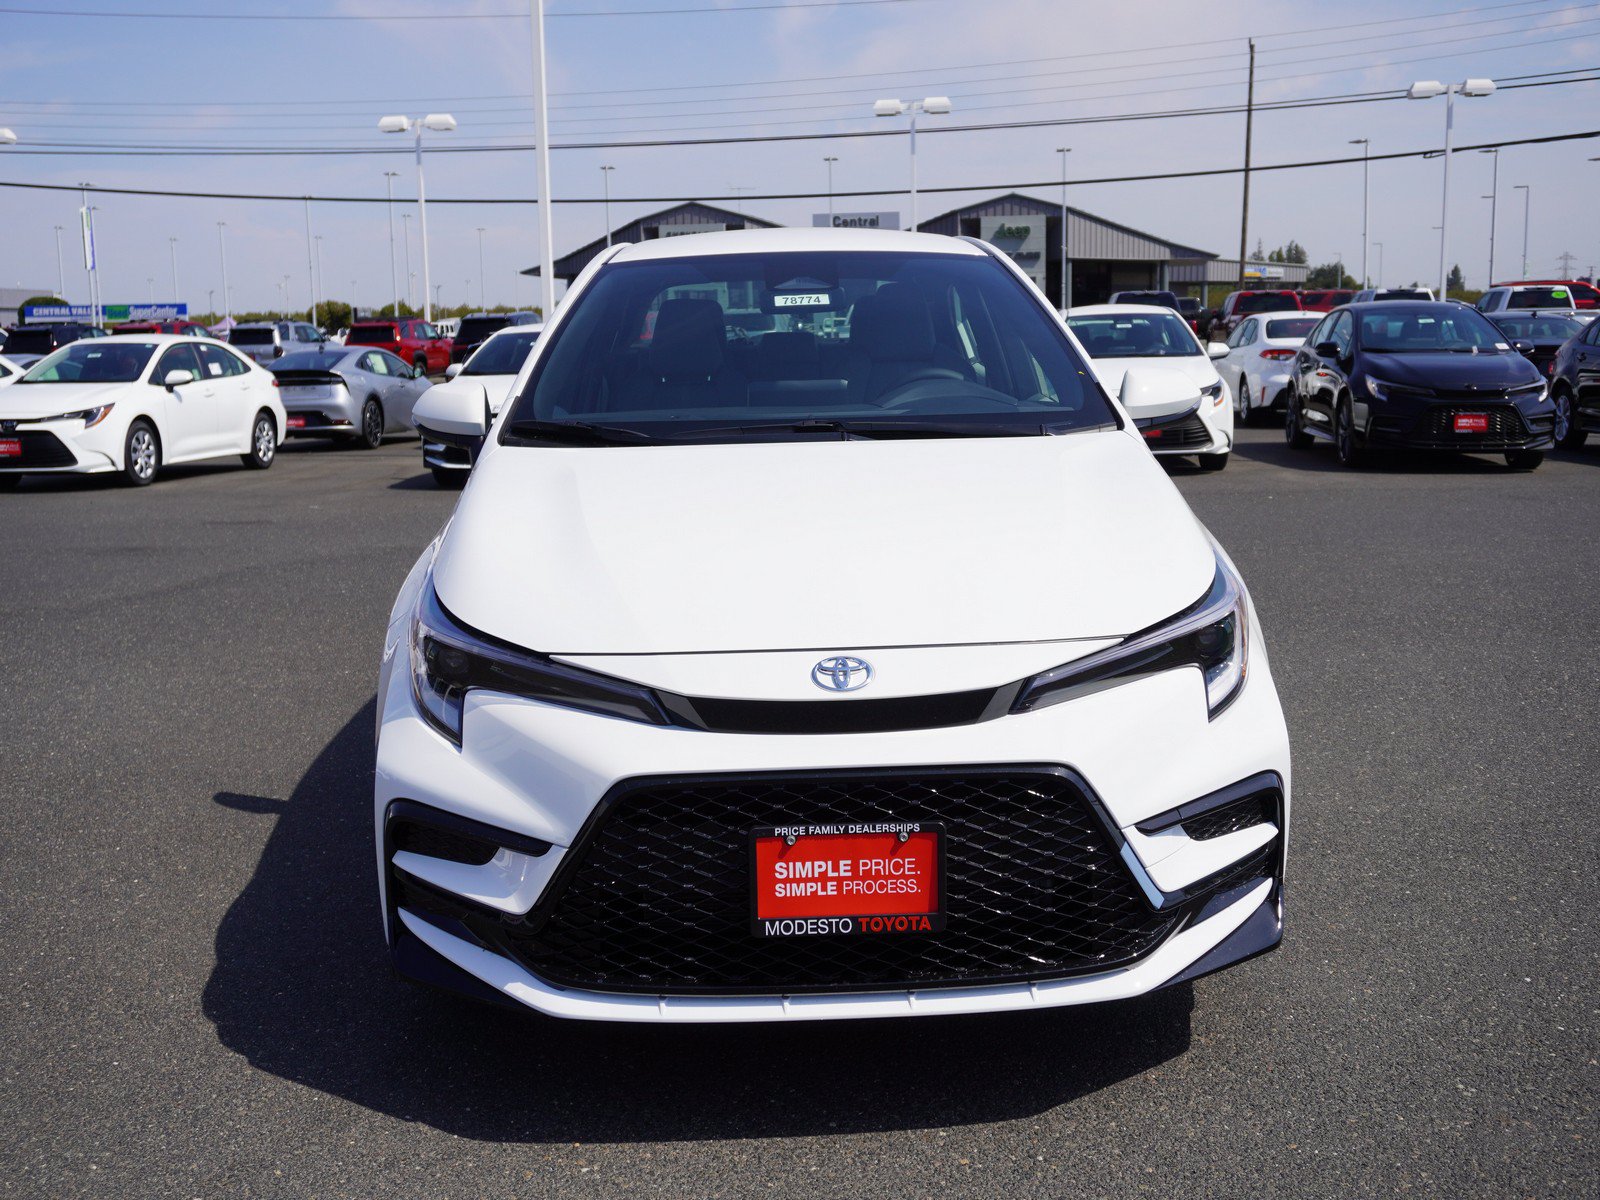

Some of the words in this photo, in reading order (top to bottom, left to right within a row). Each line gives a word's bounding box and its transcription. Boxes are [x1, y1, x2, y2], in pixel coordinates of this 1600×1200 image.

[832, 214, 880, 228] Central
[782, 296, 821, 305] 78774
[33, 306, 71, 317] CENTRAL
[774, 826, 806, 837] PRICE
[808, 825, 845, 835] FAMILY
[848, 823, 921, 834] DEALERSHIPS
[774, 860, 852, 879] SIMPLE
[859, 858, 921, 876] PRICE.
[774, 881, 838, 898] SIMPLE
[842, 879, 922, 895] PROCESS.
[765, 918, 852, 936] MODESTO
[858, 916, 932, 933] TOYOTA
